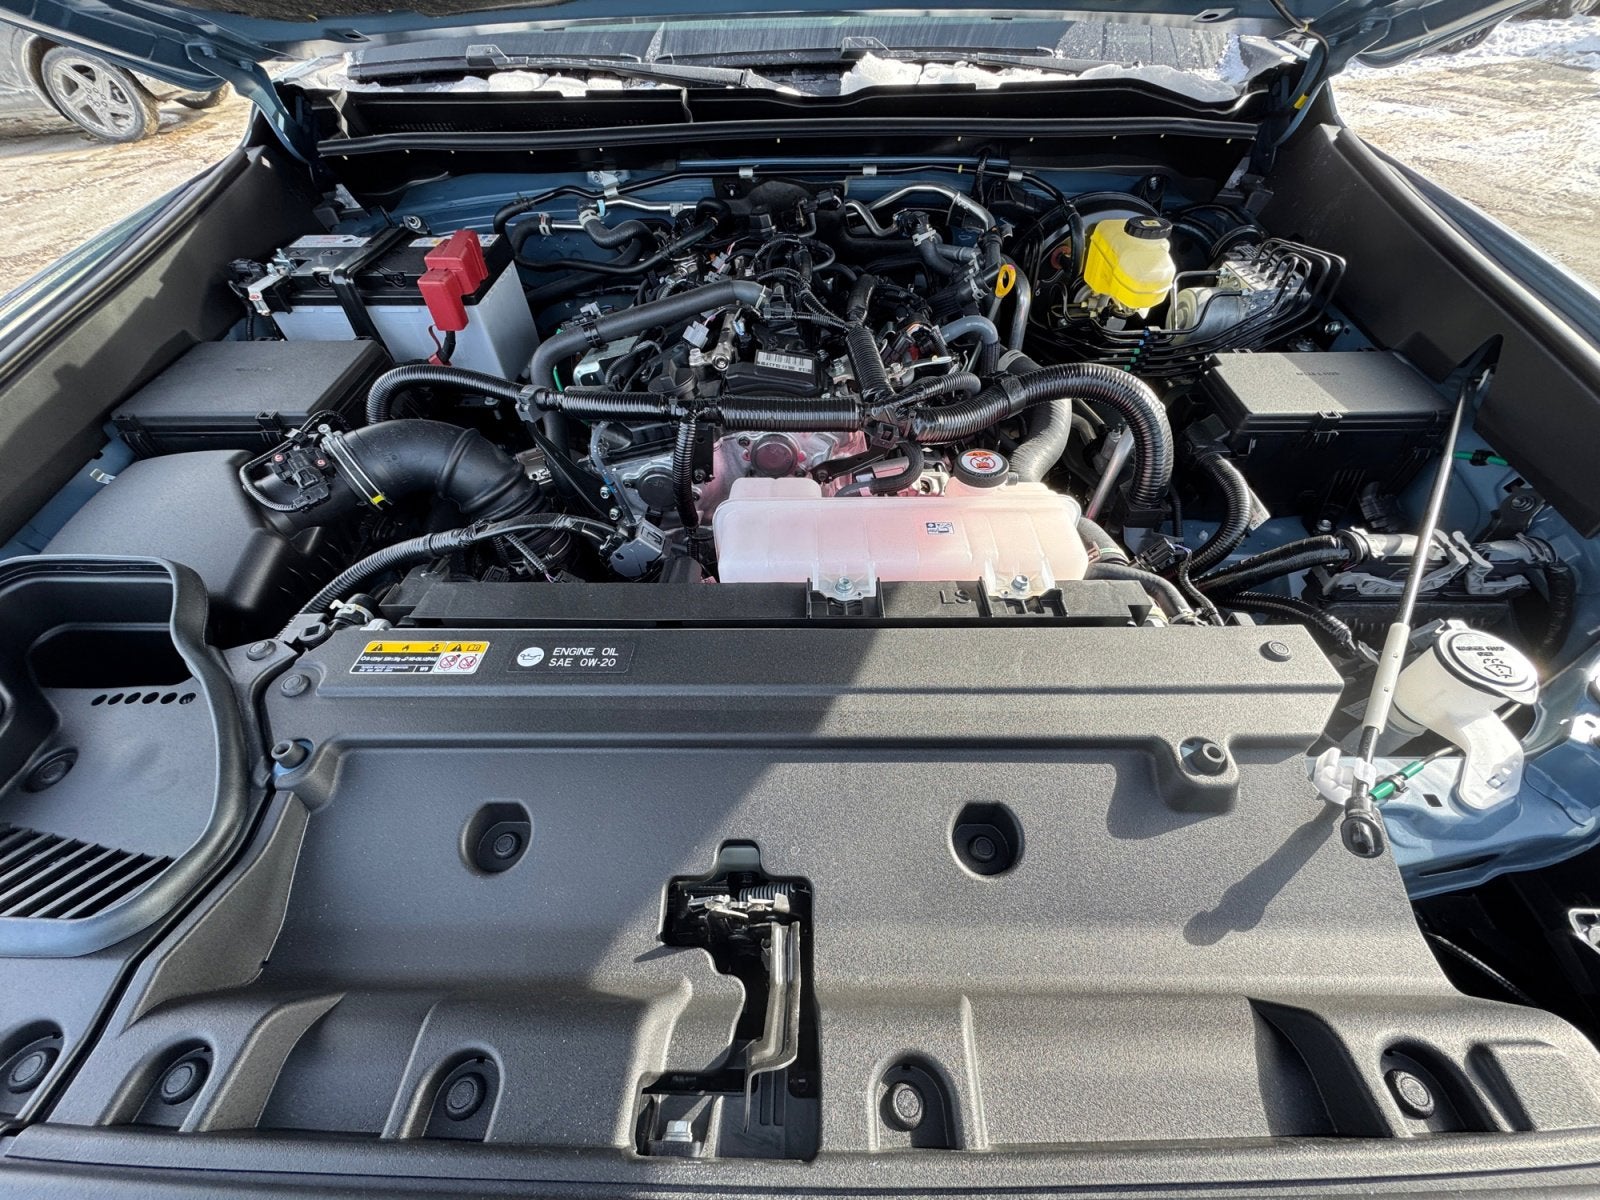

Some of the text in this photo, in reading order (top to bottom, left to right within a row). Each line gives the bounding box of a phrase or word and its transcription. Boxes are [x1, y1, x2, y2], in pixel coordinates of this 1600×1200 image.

[552, 647, 619, 656] ENGINE OIL
[548, 658, 617, 667] SAE 0W-20
